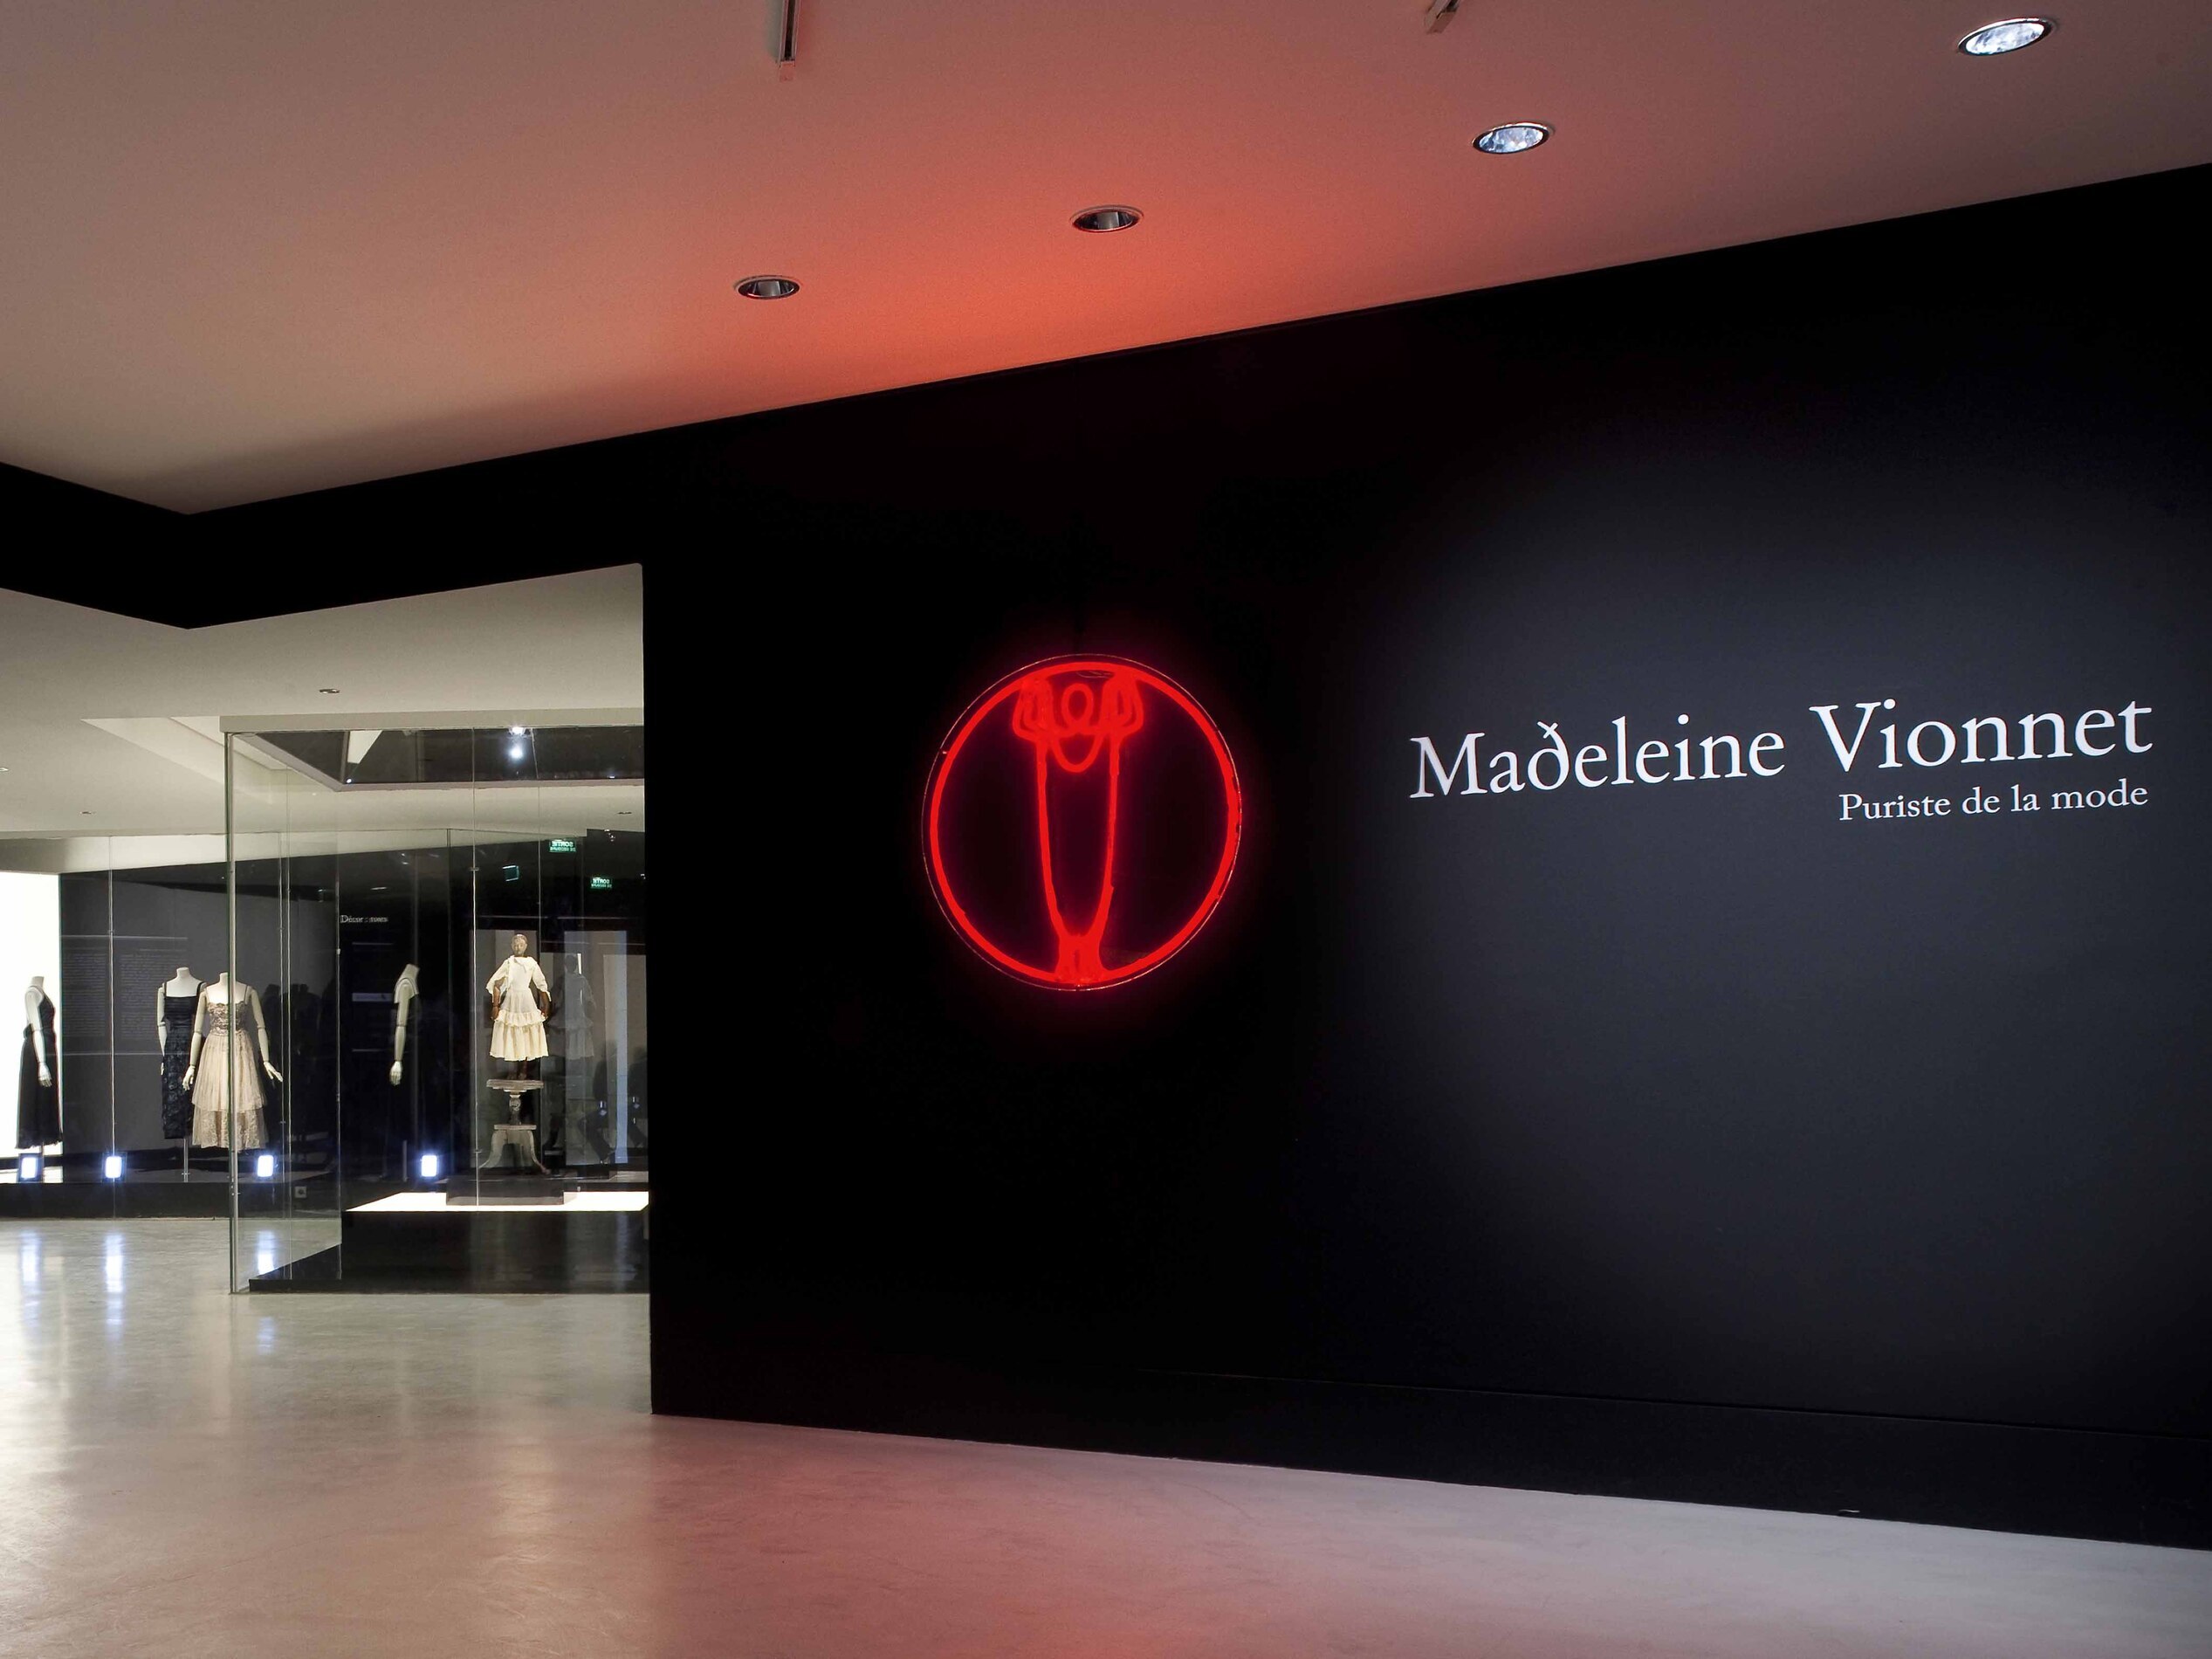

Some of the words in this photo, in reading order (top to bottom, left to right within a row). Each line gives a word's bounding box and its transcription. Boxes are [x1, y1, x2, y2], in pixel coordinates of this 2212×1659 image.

[1808, 699, 2154, 773] Vionnet
[1838, 793, 1952, 821] Puriste
[1961, 786, 2001, 815] de
[2010, 783, 2041, 812] la
[2051, 777, 2148, 810] mode
